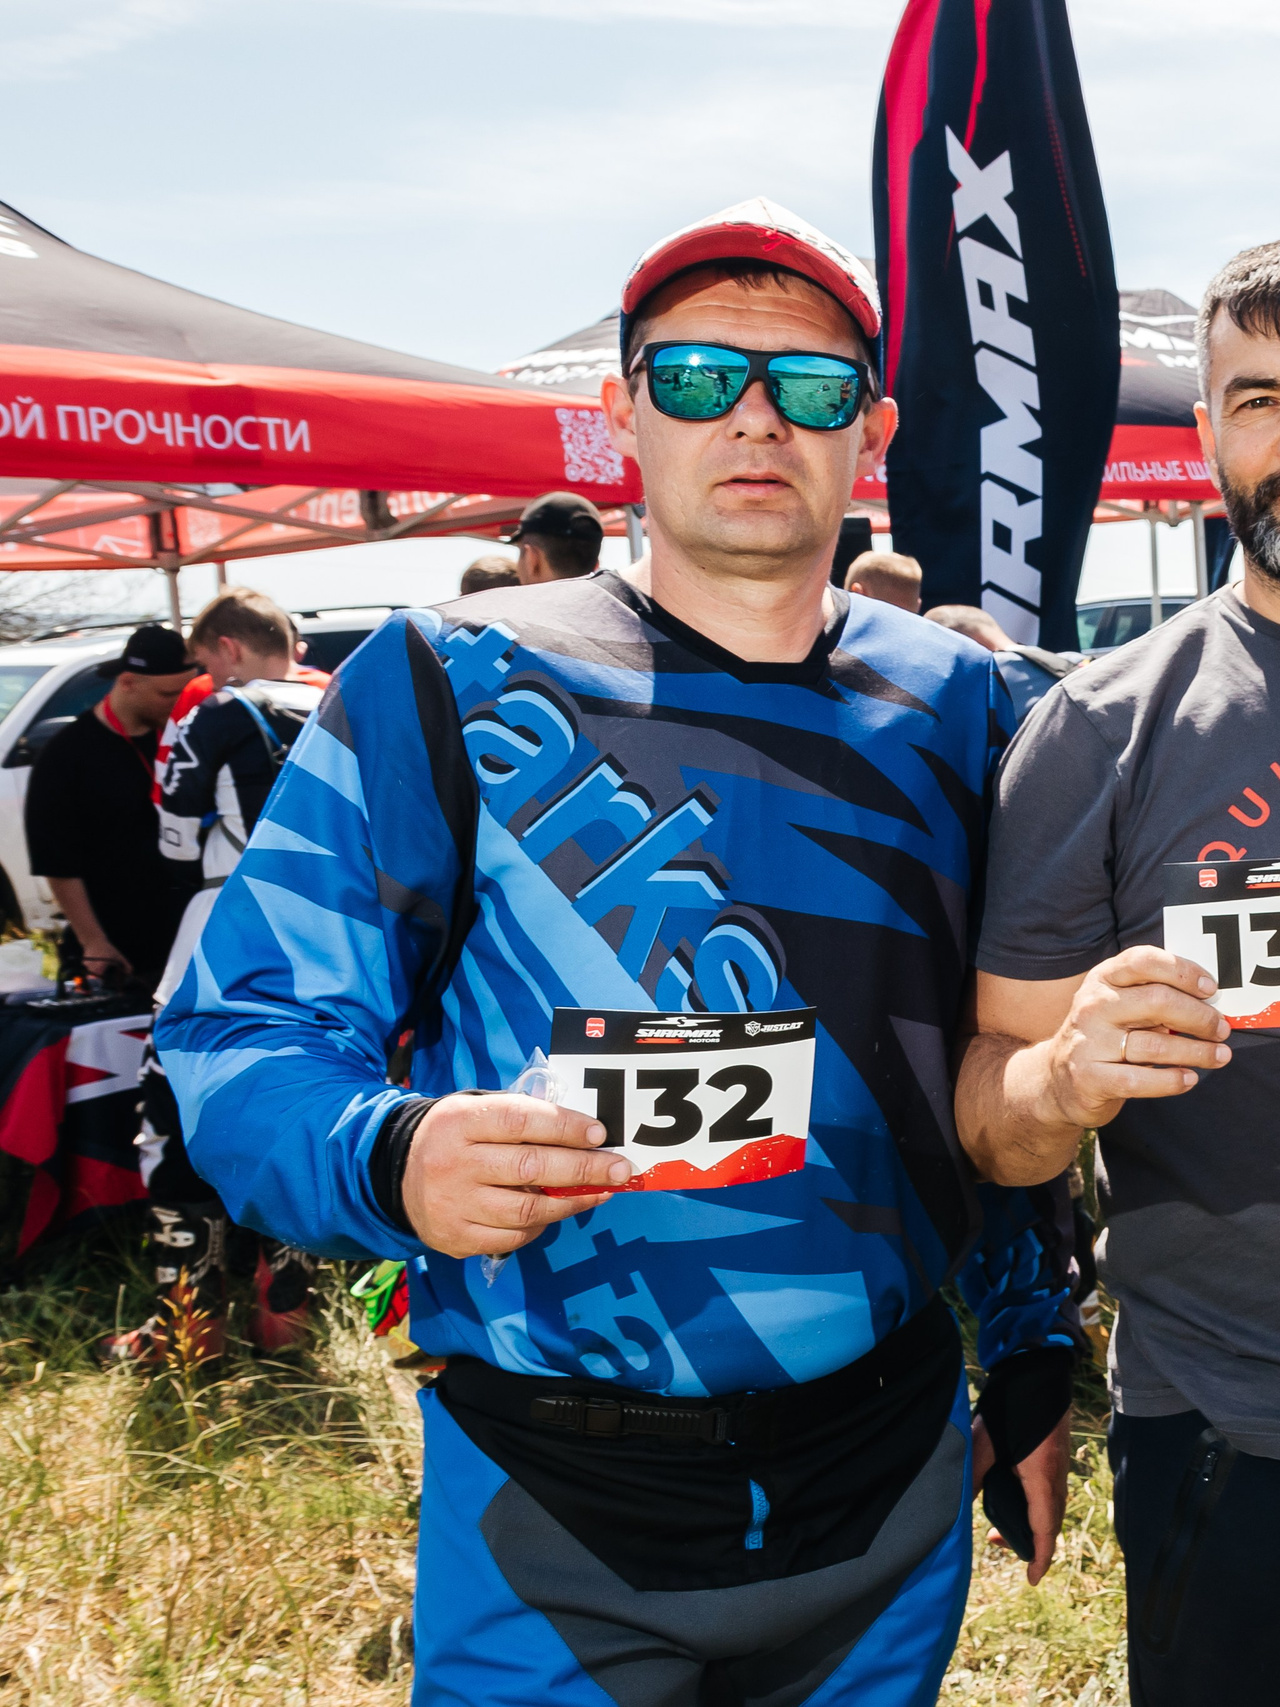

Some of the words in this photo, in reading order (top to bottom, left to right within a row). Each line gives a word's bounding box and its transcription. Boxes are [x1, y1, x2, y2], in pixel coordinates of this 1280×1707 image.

[56, 405, 311, 453] ПРОЧНОСТИ
[1102, 460, 1187, 482] ИЛЬНЫЕ
[634, 1028, 723, 1038] SHARMAX
[583, 1064, 773, 1148] 132
